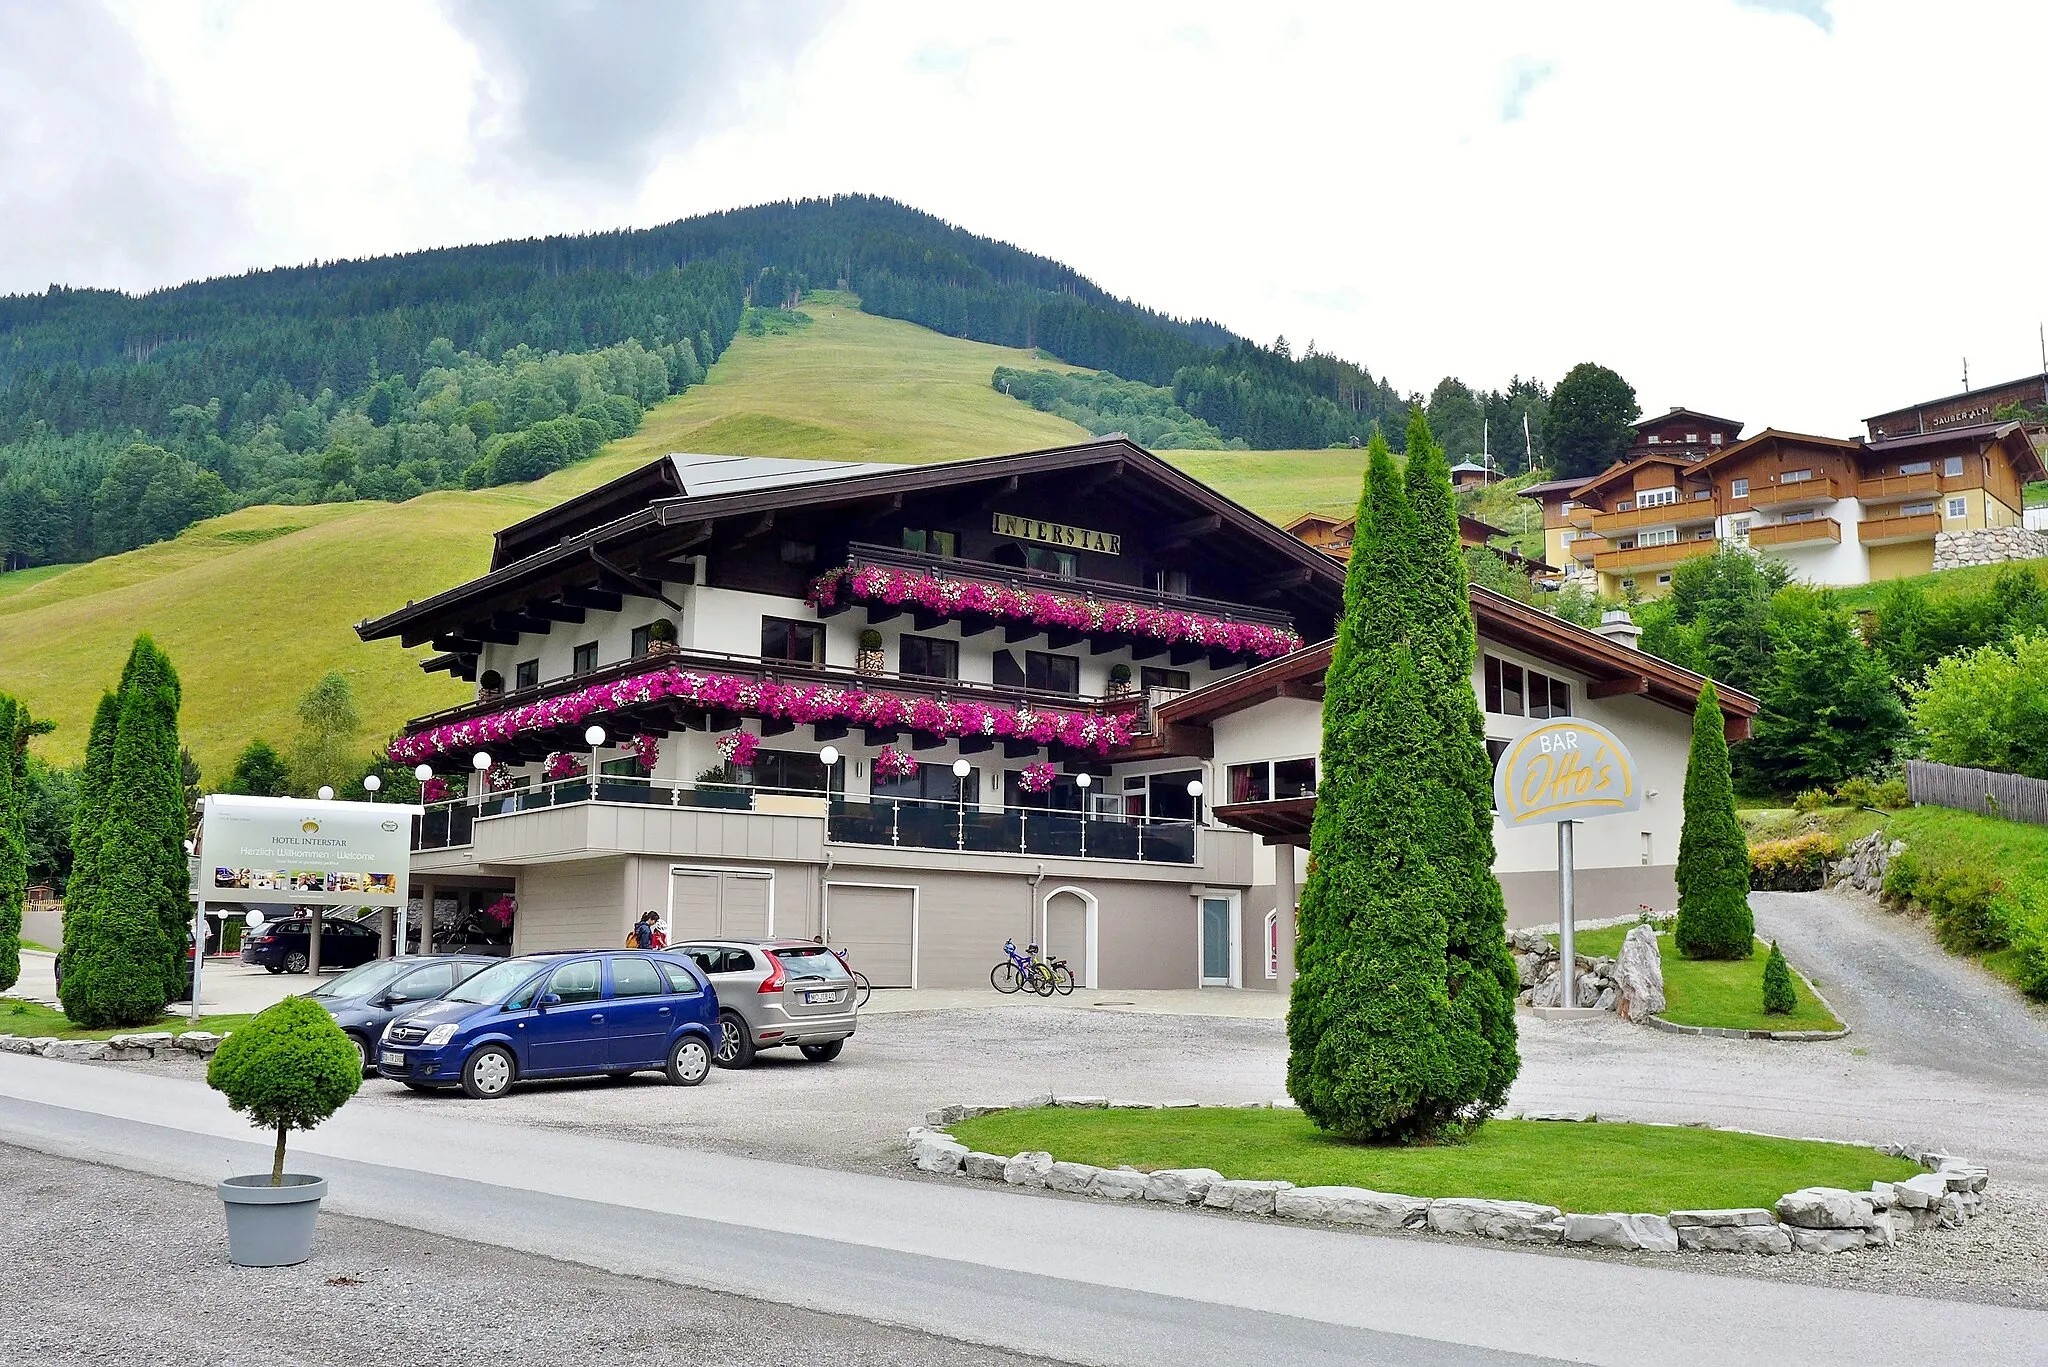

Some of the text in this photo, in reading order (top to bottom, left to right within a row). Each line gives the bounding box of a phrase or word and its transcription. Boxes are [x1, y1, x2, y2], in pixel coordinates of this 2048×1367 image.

[1970, 407, 1989, 417] ALM
[994, 514, 1120, 553] INTERSTAR
[1540, 731, 1578, 753] BAR
[1522, 746, 1612, 806] Otto's
[272, 837, 347, 847] HOTEL INTERSTAR
[240, 847, 375, 861] Herzlich Willkommen Welcome
